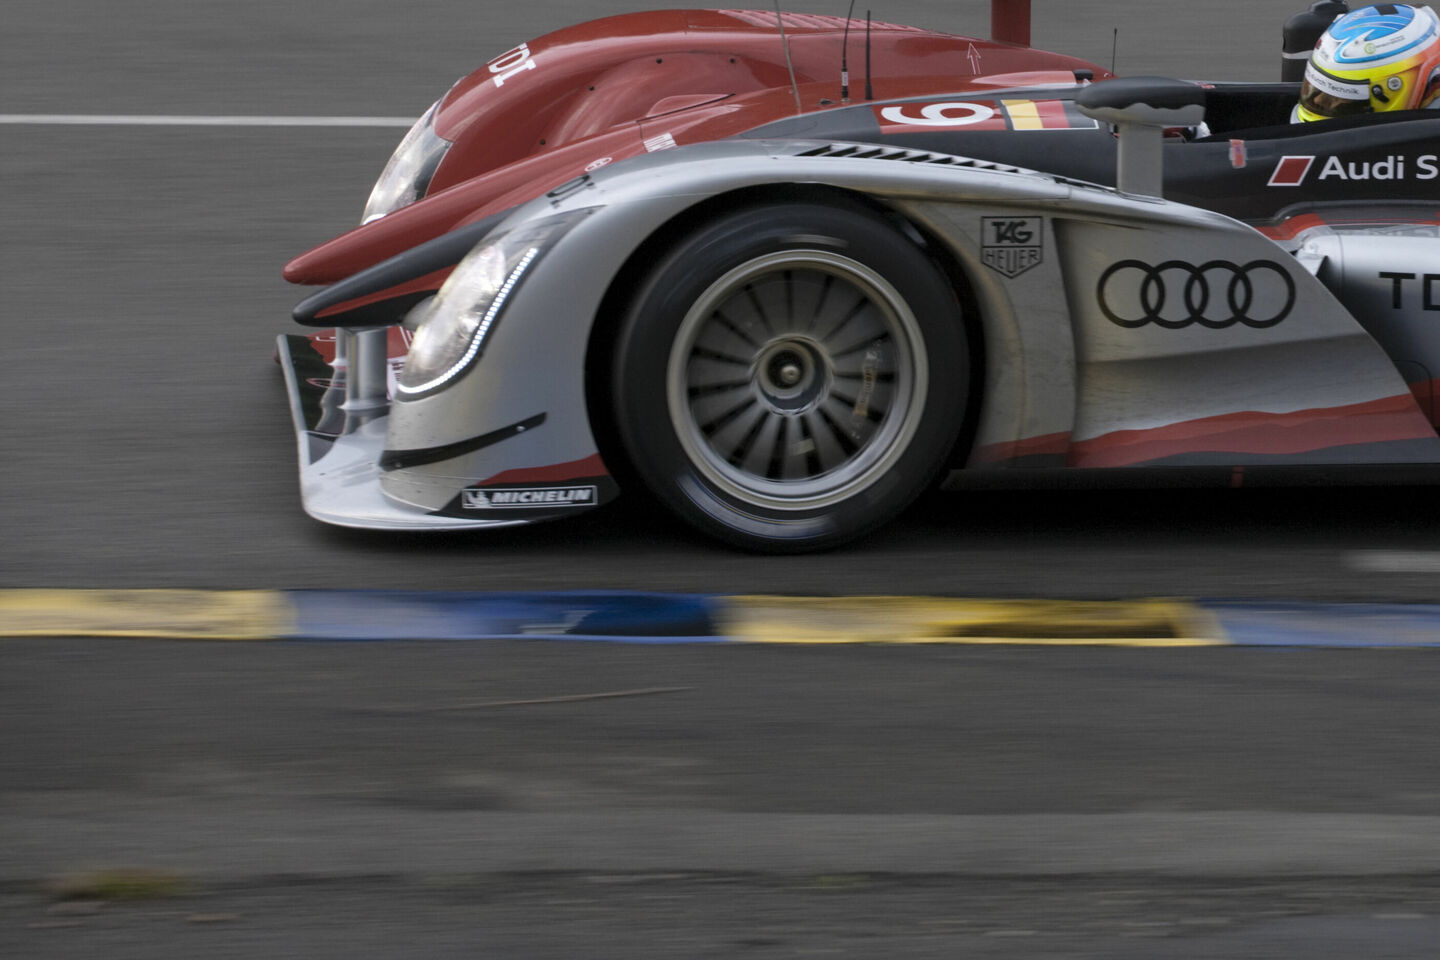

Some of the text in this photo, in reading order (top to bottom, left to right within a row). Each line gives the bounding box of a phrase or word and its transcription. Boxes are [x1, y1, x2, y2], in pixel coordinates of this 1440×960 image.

[1318, 155, 1405, 180] Audi
[991, 221, 1034, 243] TAG
[985, 250, 1039, 274] HEUER
[491, 489, 592, 503] MICHELIN
